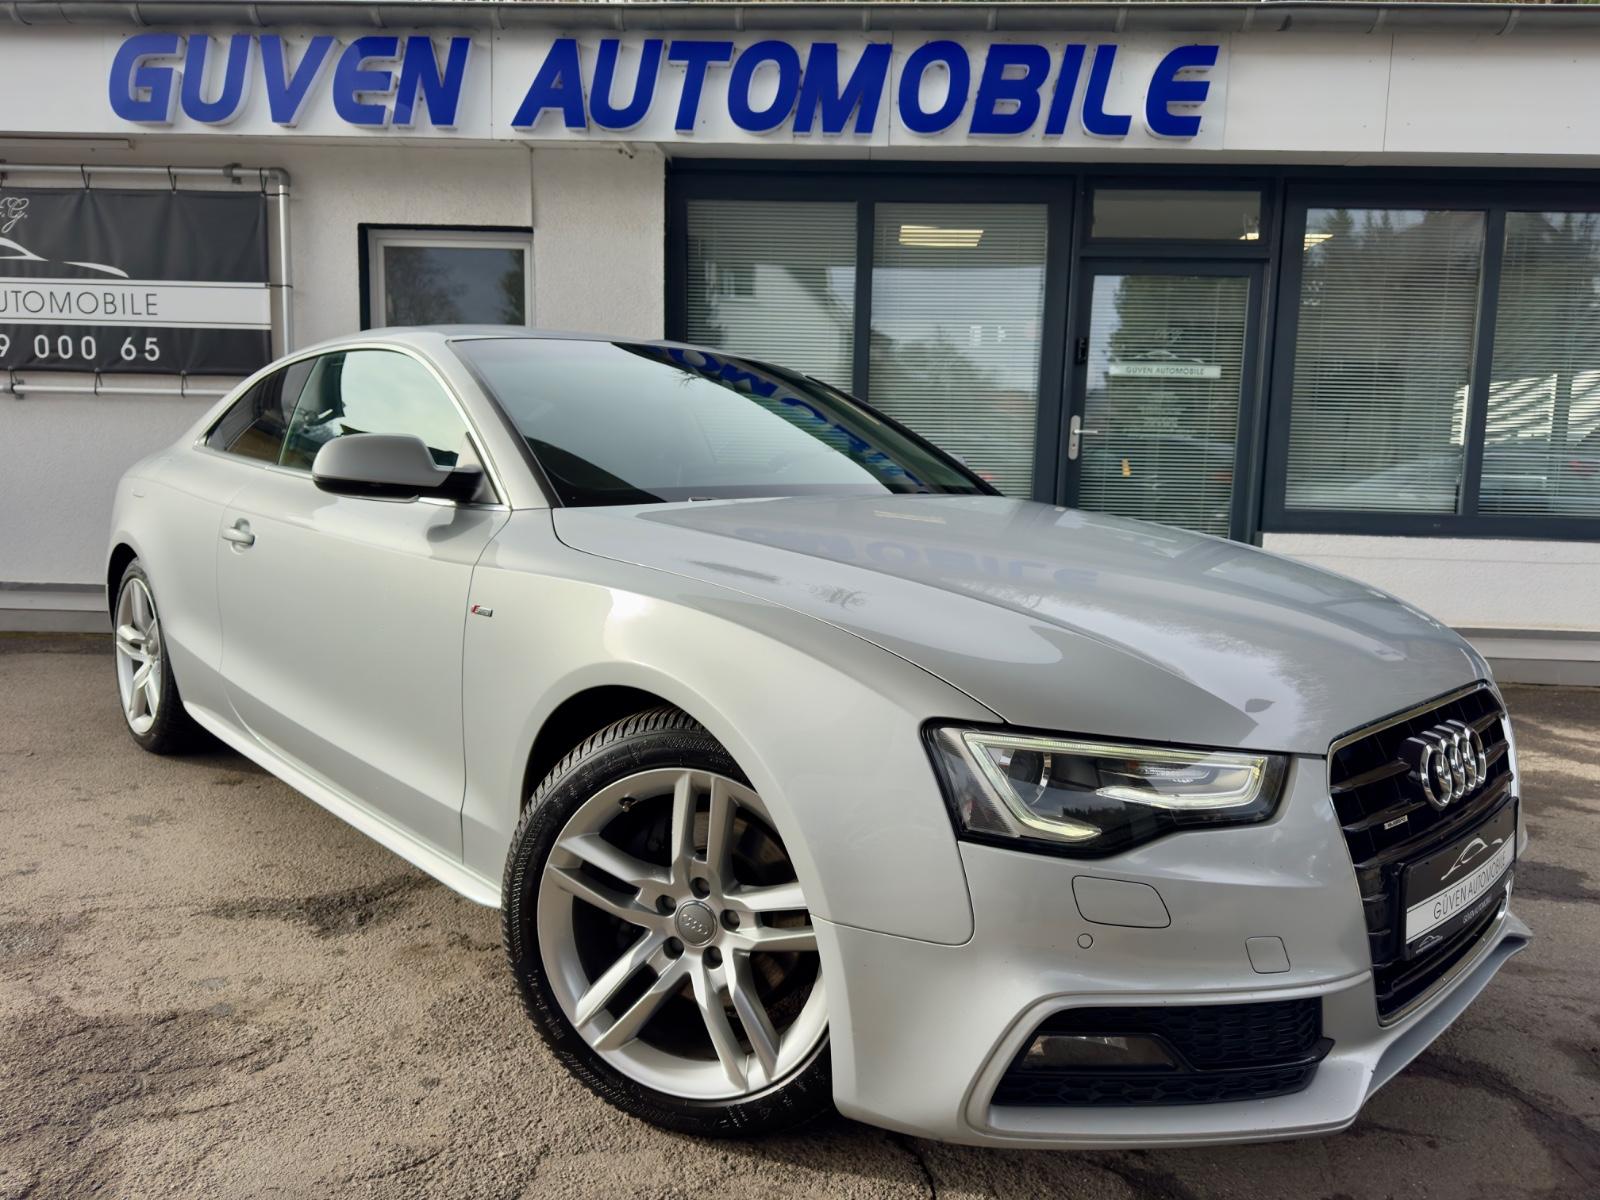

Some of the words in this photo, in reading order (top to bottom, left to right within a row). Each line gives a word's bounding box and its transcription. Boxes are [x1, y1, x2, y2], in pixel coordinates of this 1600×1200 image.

[108, 33, 472, 127] GUVEN
[510, 38, 1220, 139] AUTOMOBILE
[33, 334, 97, 360] 000
[120, 336, 161, 362] 65
[1433, 884, 1467, 920] GÜVEN
